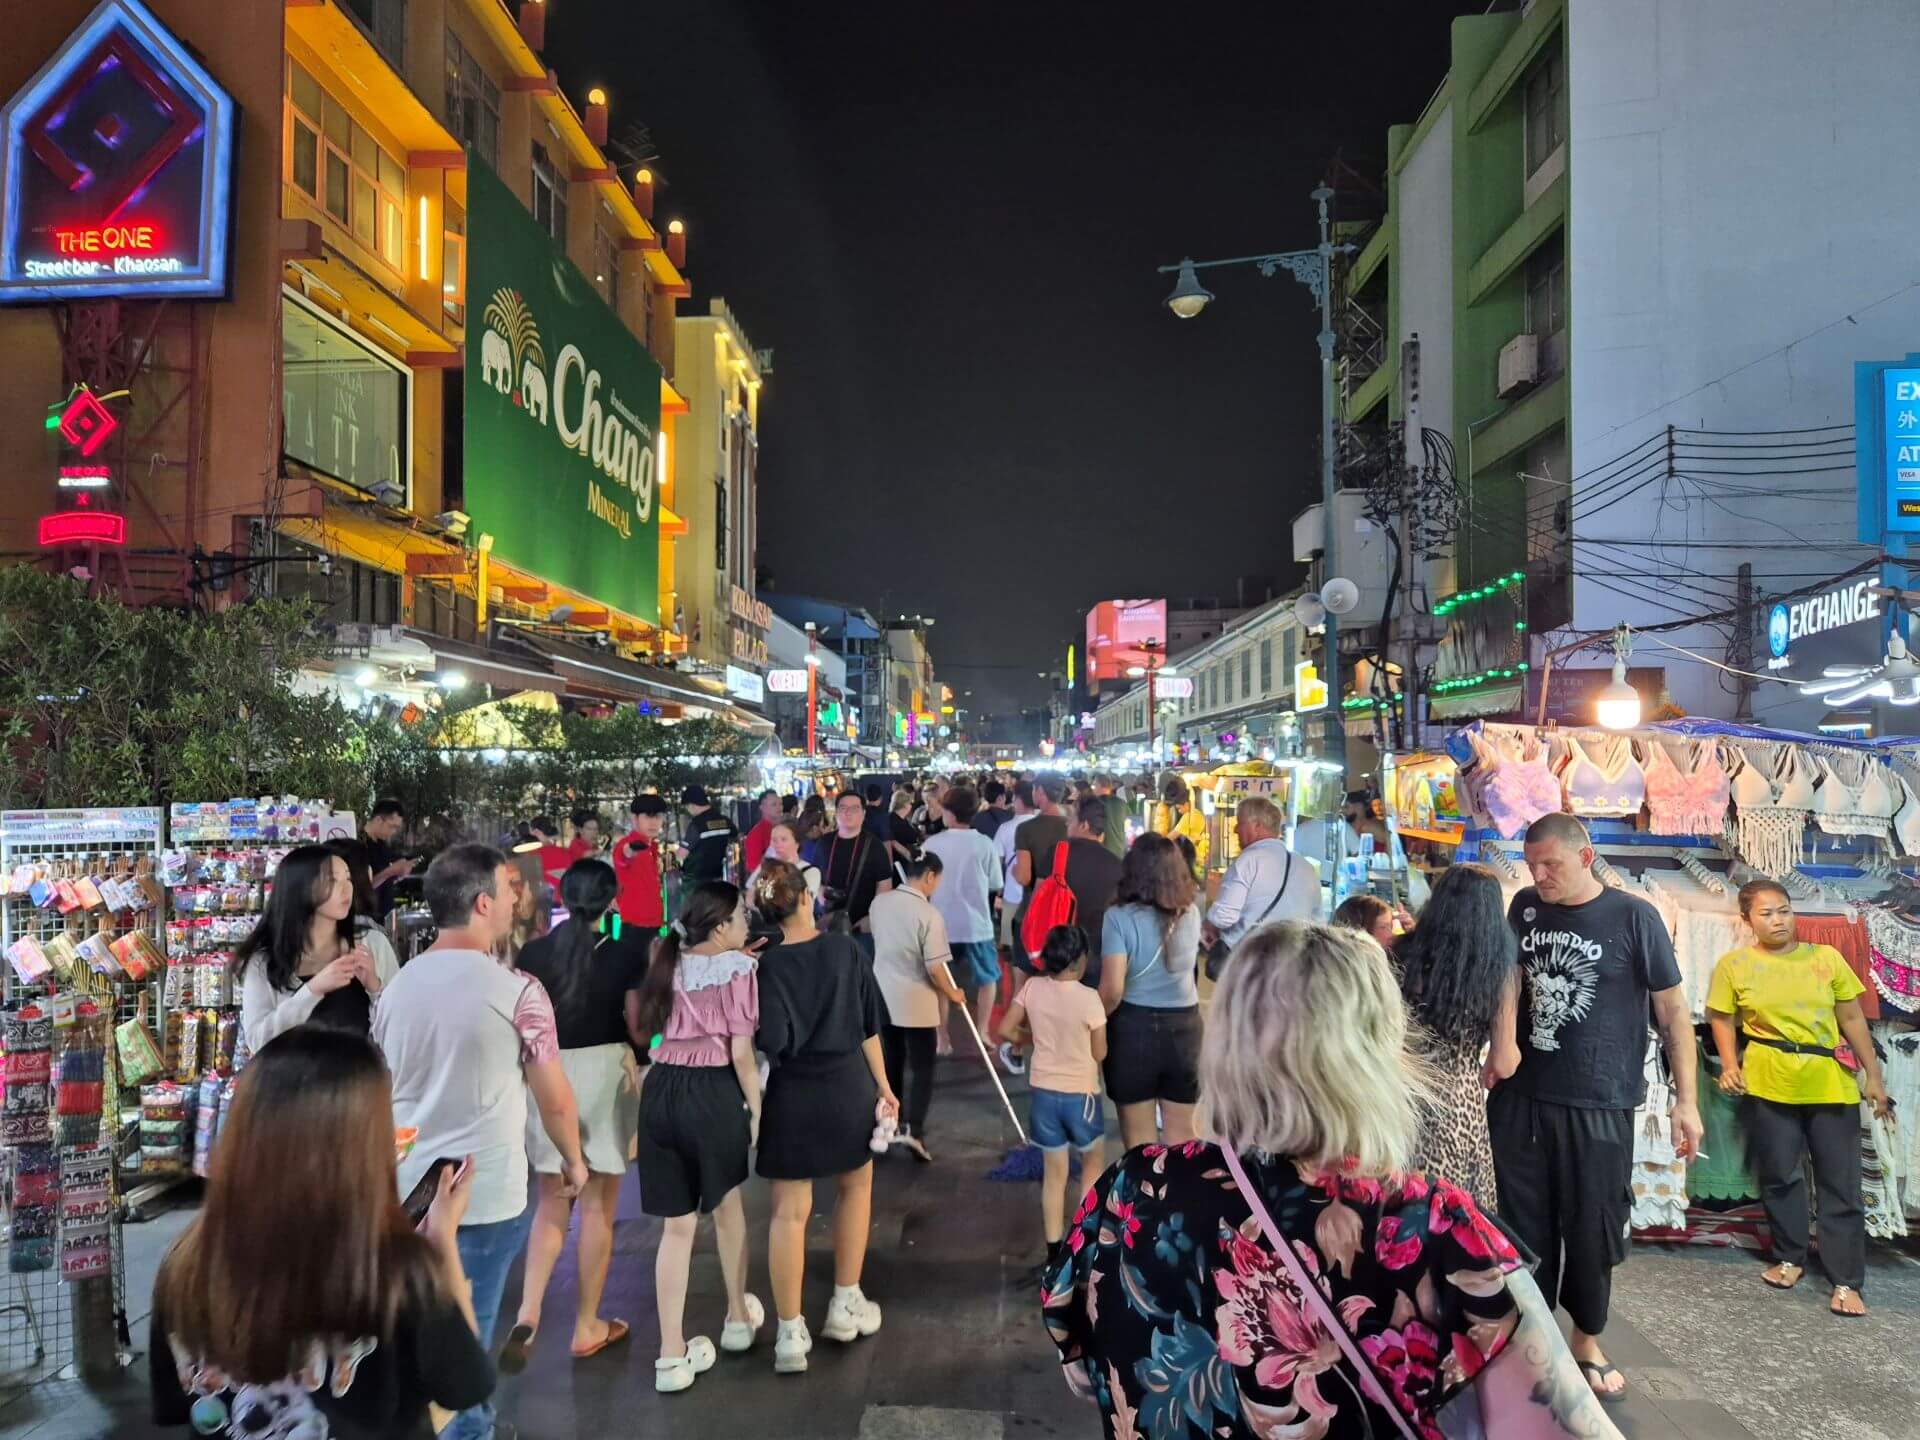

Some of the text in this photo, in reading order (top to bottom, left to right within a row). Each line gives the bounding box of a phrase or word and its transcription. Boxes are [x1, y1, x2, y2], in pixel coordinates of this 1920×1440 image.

[56, 227, 152, 252] THE ONE
[114, 256, 179, 273] Khaosan
[1898, 410, 1918, 429] 外
[553, 343, 654, 523] Chang
[1790, 578, 1881, 641] EXCHANGE
